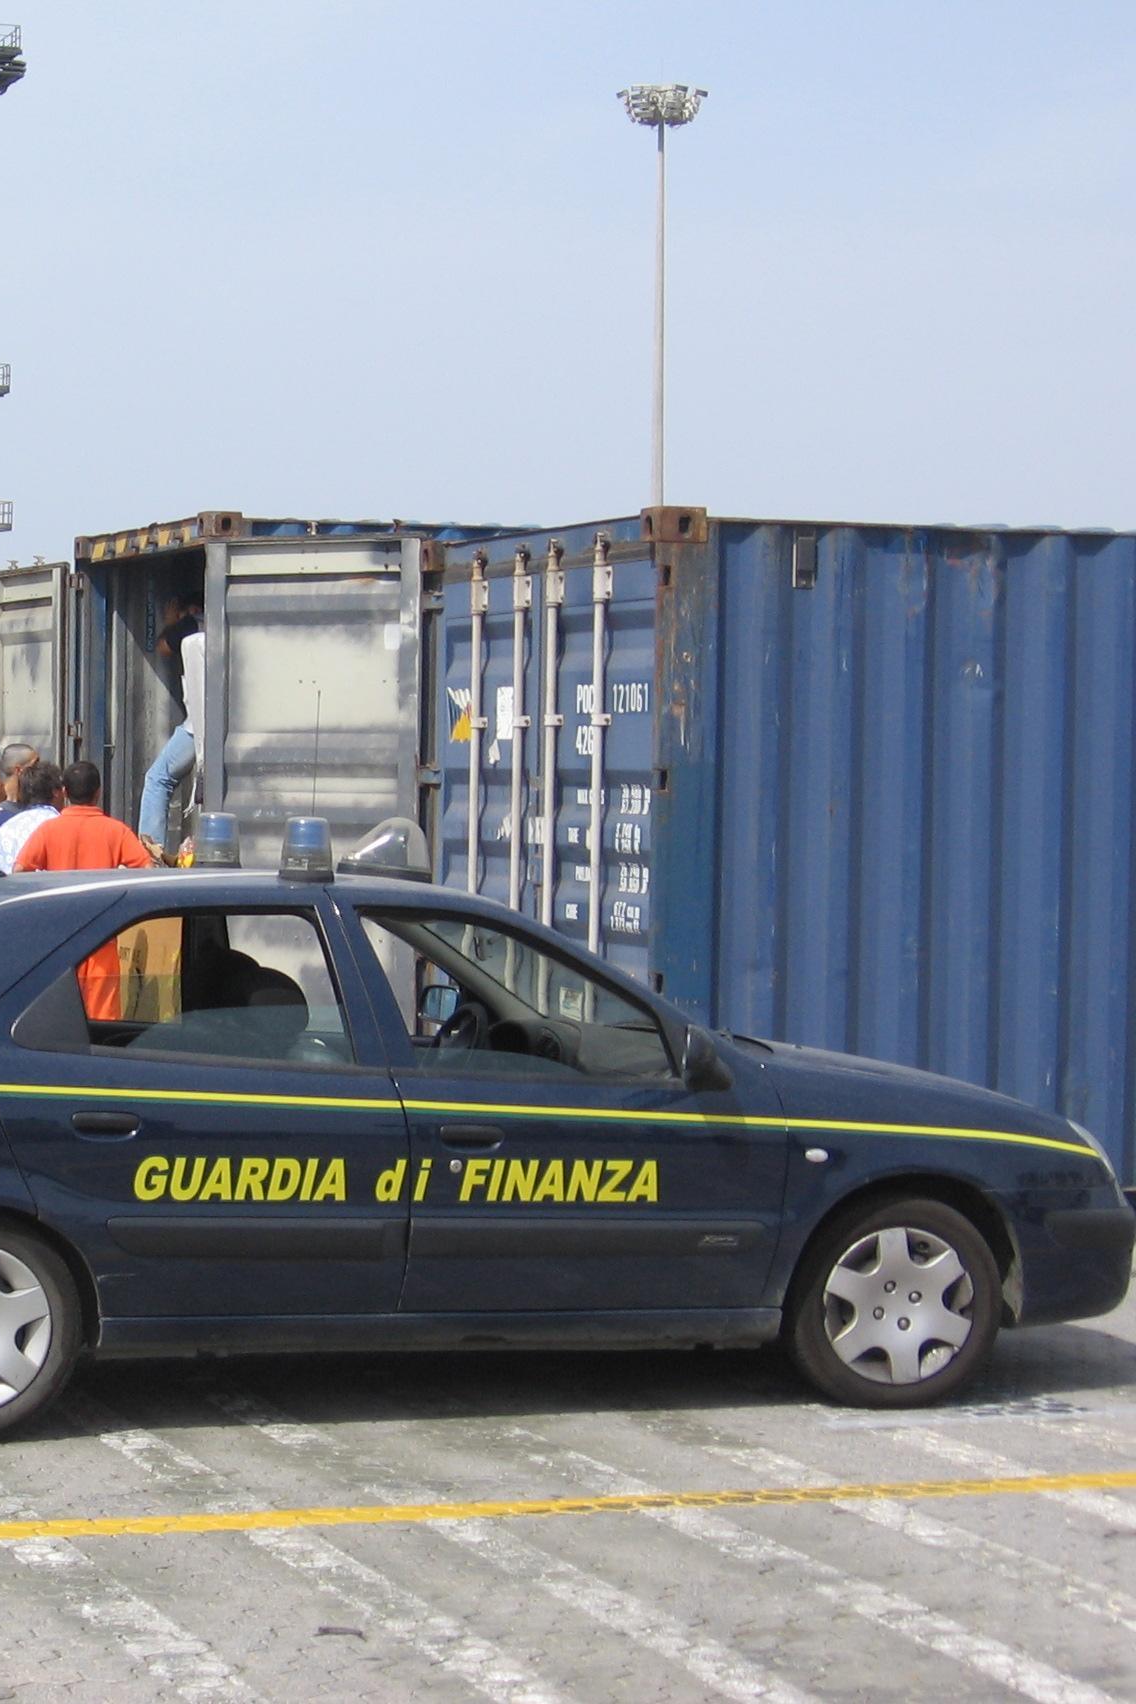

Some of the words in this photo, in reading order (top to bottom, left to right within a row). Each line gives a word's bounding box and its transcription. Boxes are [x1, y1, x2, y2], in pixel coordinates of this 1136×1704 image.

[612, 682, 649, 713] 121061
[133, 1156, 347, 1201] GUARDIA
[375, 1159, 432, 1201] di
[459, 1159, 659, 1201] FINANZA
